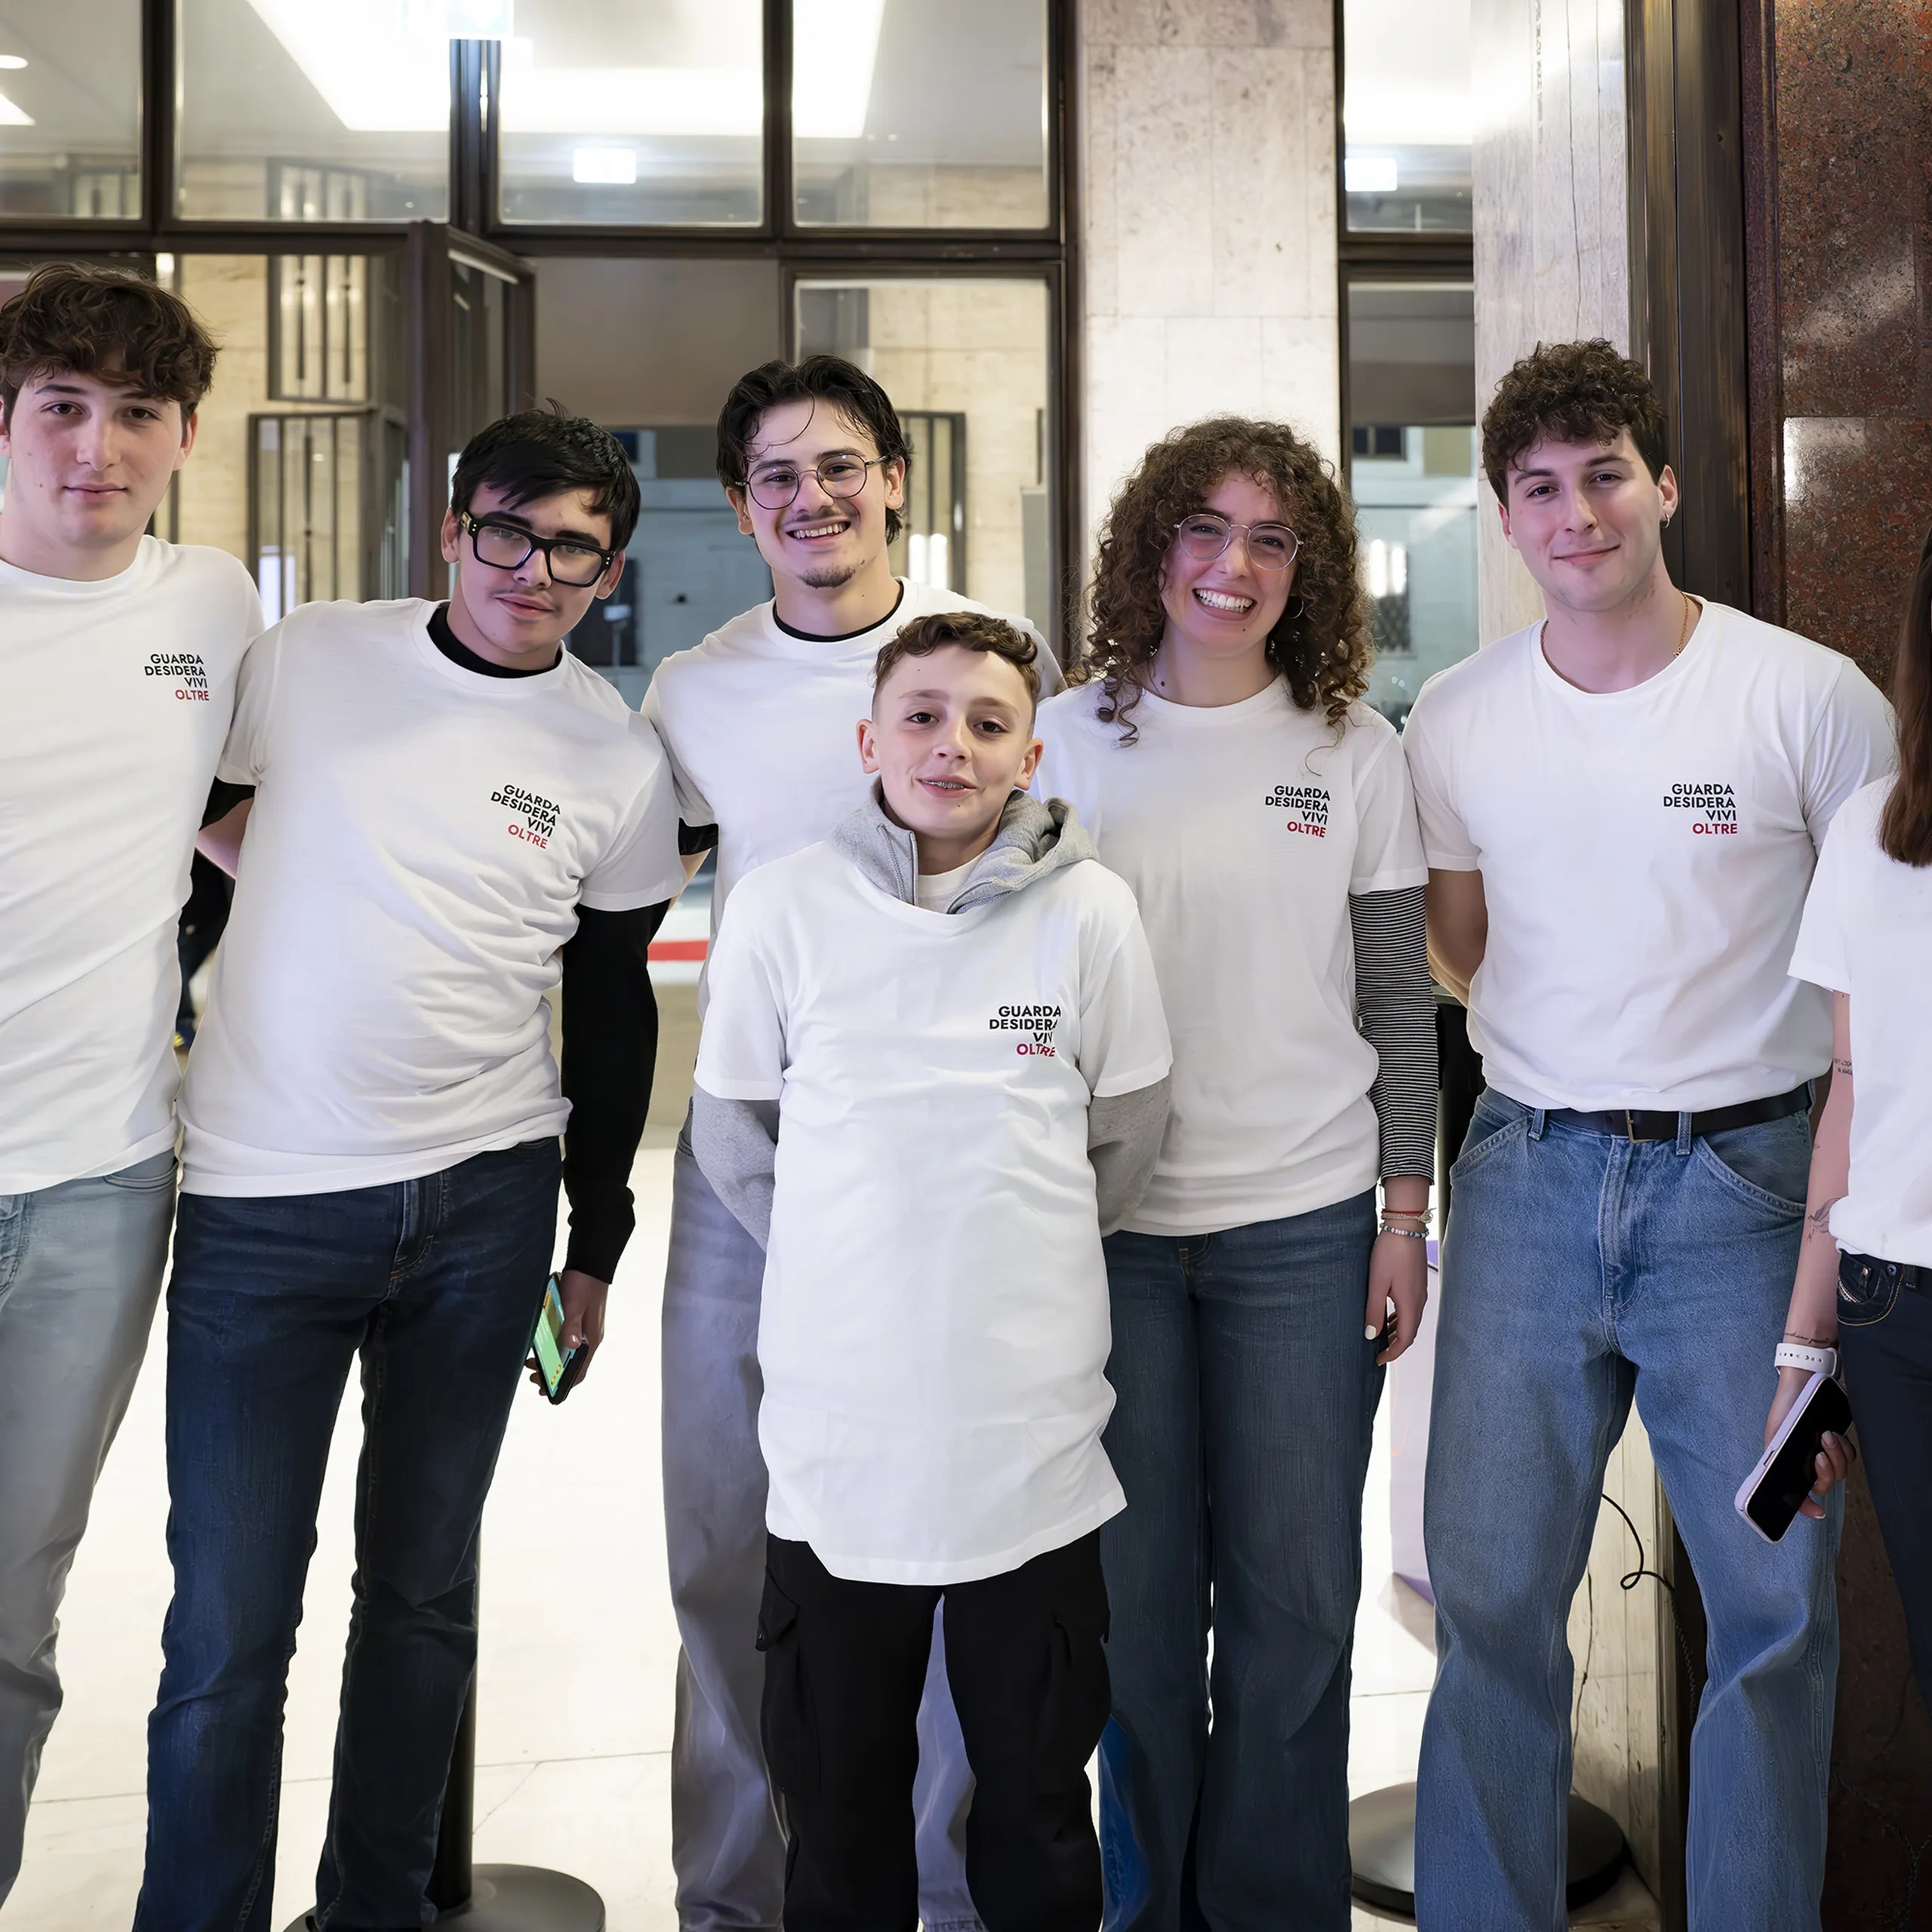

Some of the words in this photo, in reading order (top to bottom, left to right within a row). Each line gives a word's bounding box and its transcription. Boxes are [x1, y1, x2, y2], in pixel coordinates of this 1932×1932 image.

[150, 654, 204, 664] GUARDA
[144, 666, 206, 676] DESIDERA
[183, 677, 208, 688] VIVI
[175, 689, 210, 701] OLTRE
[1274, 786, 1331, 801] GUARDA
[1672, 783, 1734, 795] GUARDA
[504, 784, 561, 814] GUARDA
[1265, 796, 1328, 814] DESIDERA
[1663, 796, 1736, 808] DESIDERA
[491, 791, 555, 826] DESIDERA
[1302, 811, 1327, 825] VIVI
[1705, 810, 1737, 821] VIVI
[528, 817, 553, 837] VIVI
[1287, 821, 1326, 838] OLTRE
[1692, 823, 1737, 834] OLTRE
[508, 824, 548, 849] OLTRE
[998, 1005, 1061, 1017] GUARDA
[1017, 1043, 1056, 1057] OLTRE
